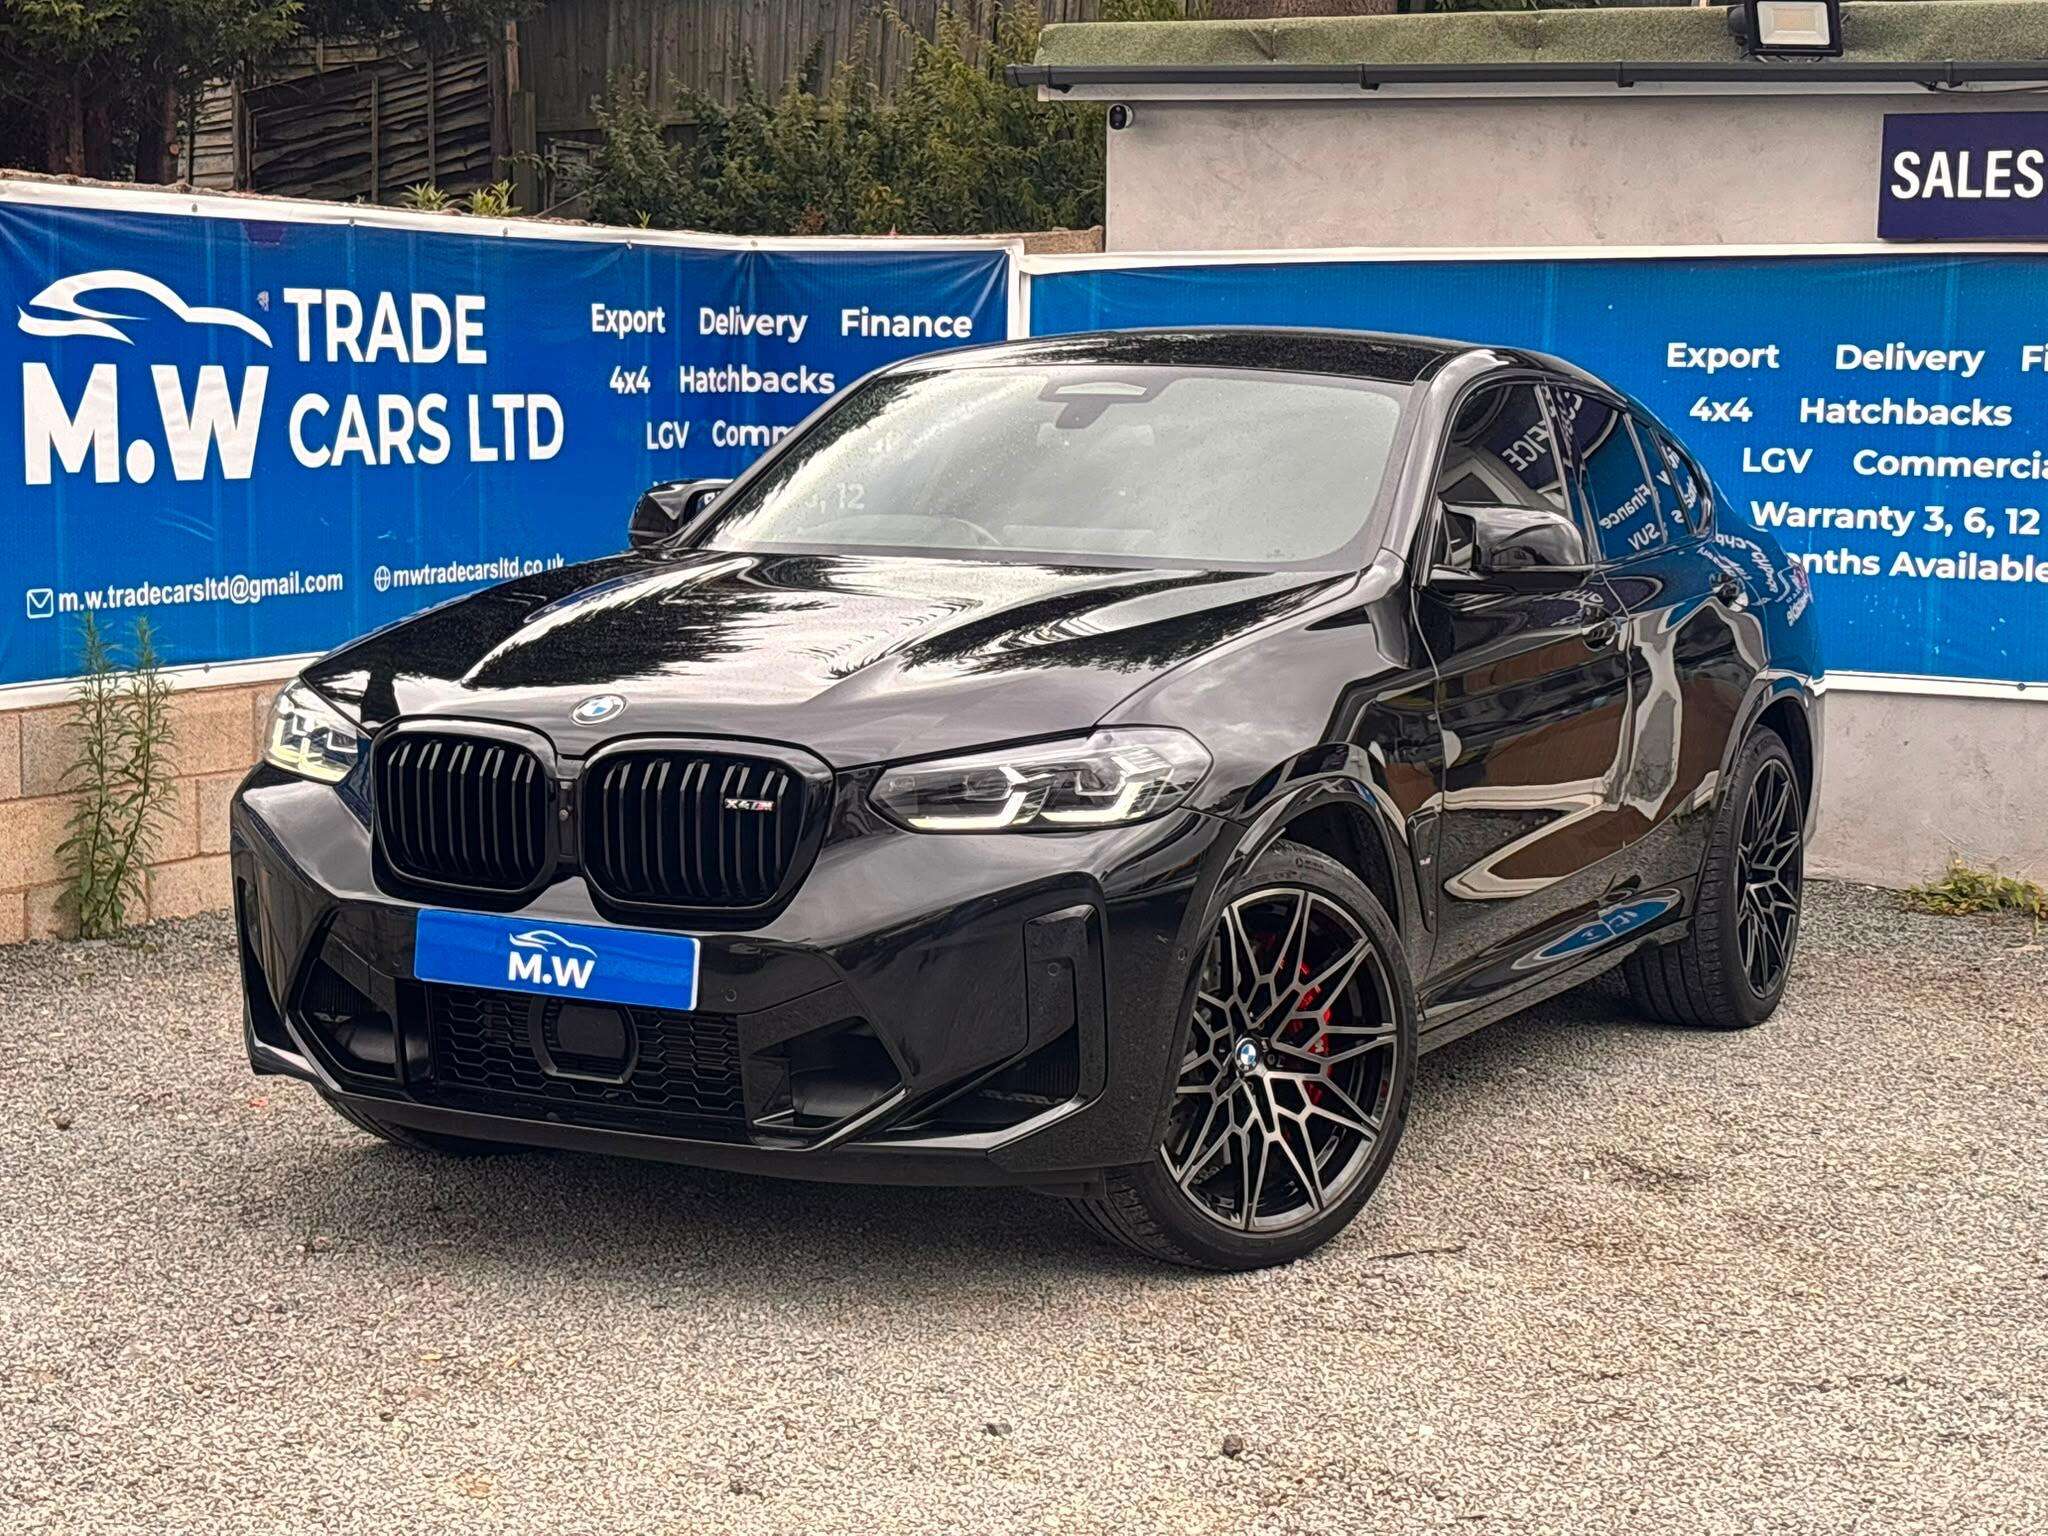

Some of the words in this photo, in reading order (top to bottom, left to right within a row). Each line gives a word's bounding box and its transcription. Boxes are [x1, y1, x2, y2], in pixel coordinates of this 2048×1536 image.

[1891, 149, 2044, 199] SALES
[283, 288, 488, 364] TRADE
[591, 303, 666, 339] Export
[699, 306, 808, 343] Delivery
[841, 306, 973, 339] Finance
[1667, 342, 1780, 374] Export
[1835, 343, 1985, 378] Delivery
[609, 366, 651, 394] 4x4
[679, 365, 835, 395] Hatchbacks
[22, 362, 270, 485] M.W
[288, 393, 451, 468] CARS
[468, 393, 565, 462] LTD
[1689, 397, 1753, 423] 4x4
[1800, 397, 2013, 427] Hatchbacks
[646, 421, 690, 450] LGV
[1743, 447, 1813, 475] LGV
[1750, 501, 1914, 536] Warranty
[1924, 505, 1953, 538] 3,
[1963, 506, 1995, 539] 6,
[2005, 507, 2041, 536] 12
[393, 553, 565, 587] mwtradecarsltd.couk
[1889, 549, 2048, 583] Available
[58, 570, 344, 613] m.w.tradecarsltd@gmail.com
[507, 950, 596, 990] M.W
